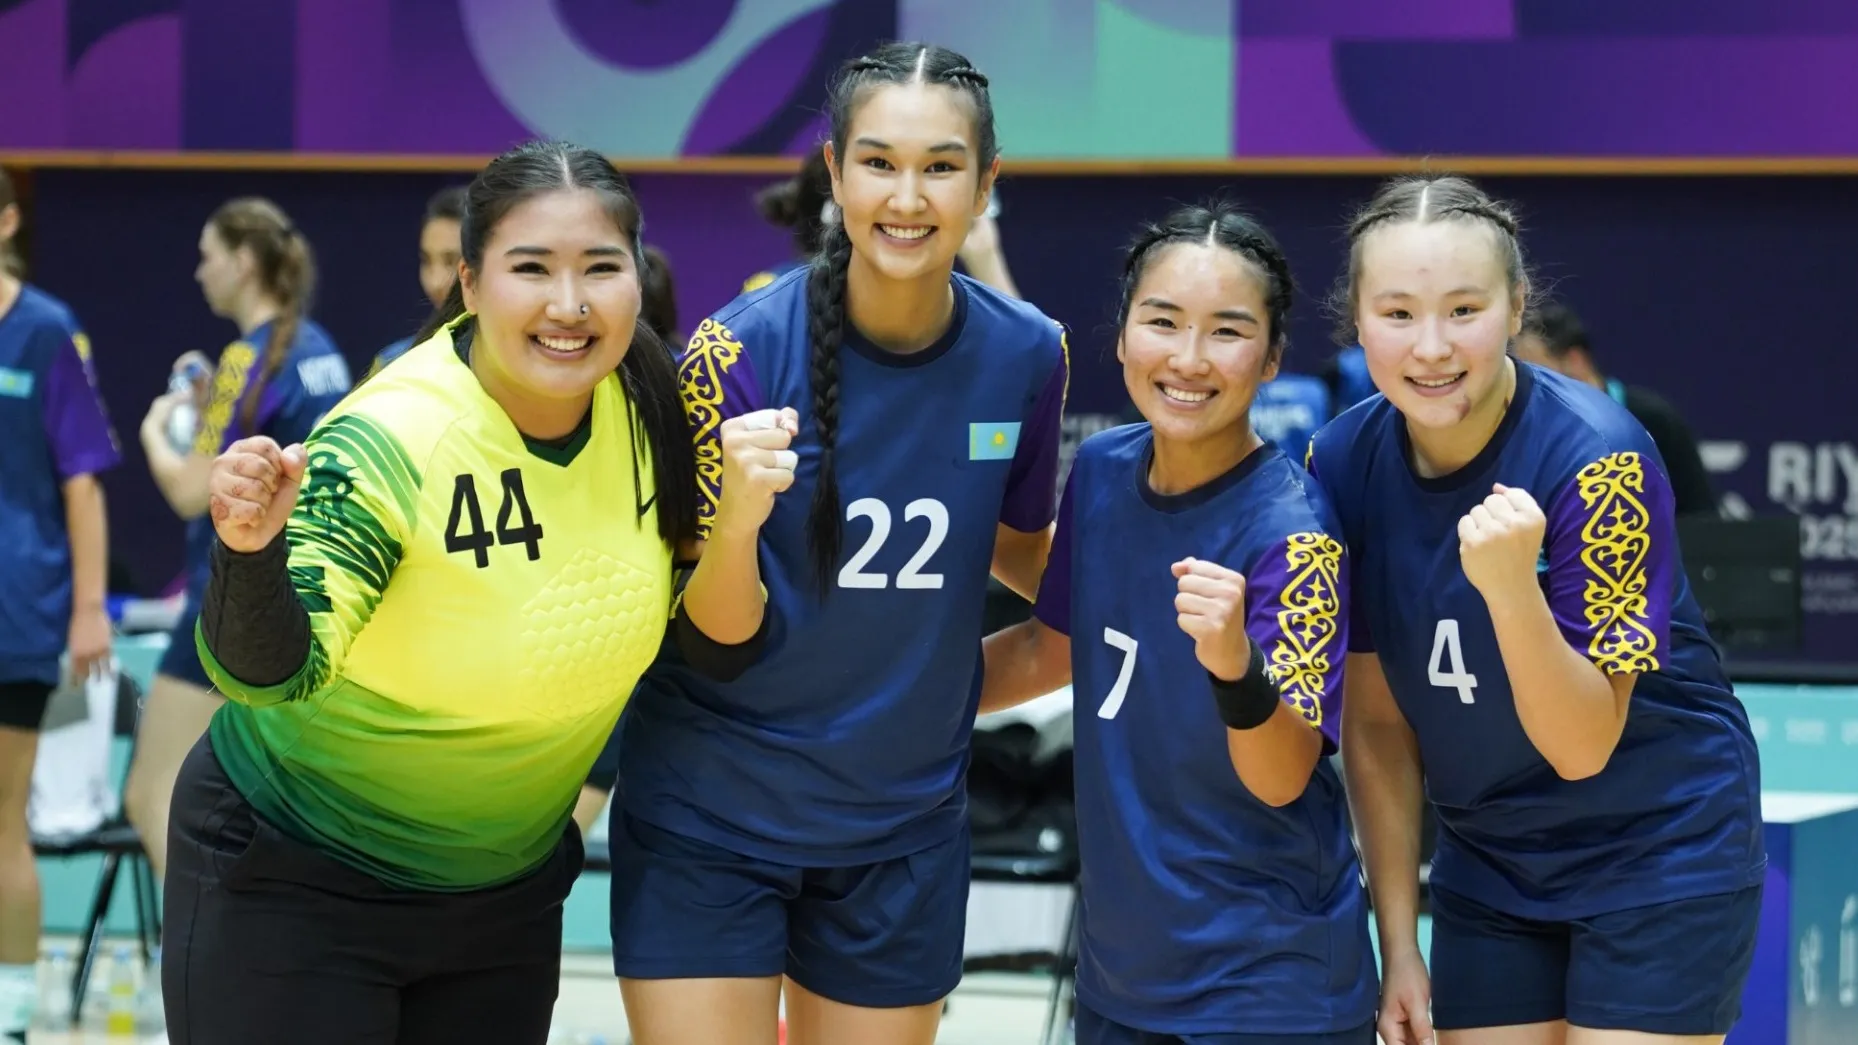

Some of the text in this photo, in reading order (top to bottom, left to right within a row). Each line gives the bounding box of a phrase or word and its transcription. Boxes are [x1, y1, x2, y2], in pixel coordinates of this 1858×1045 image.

[444, 467, 544, 569] 44
[837, 497, 950, 590] 22
[1097, 626, 1139, 720] 7
[1427, 618, 1478, 705] 4
